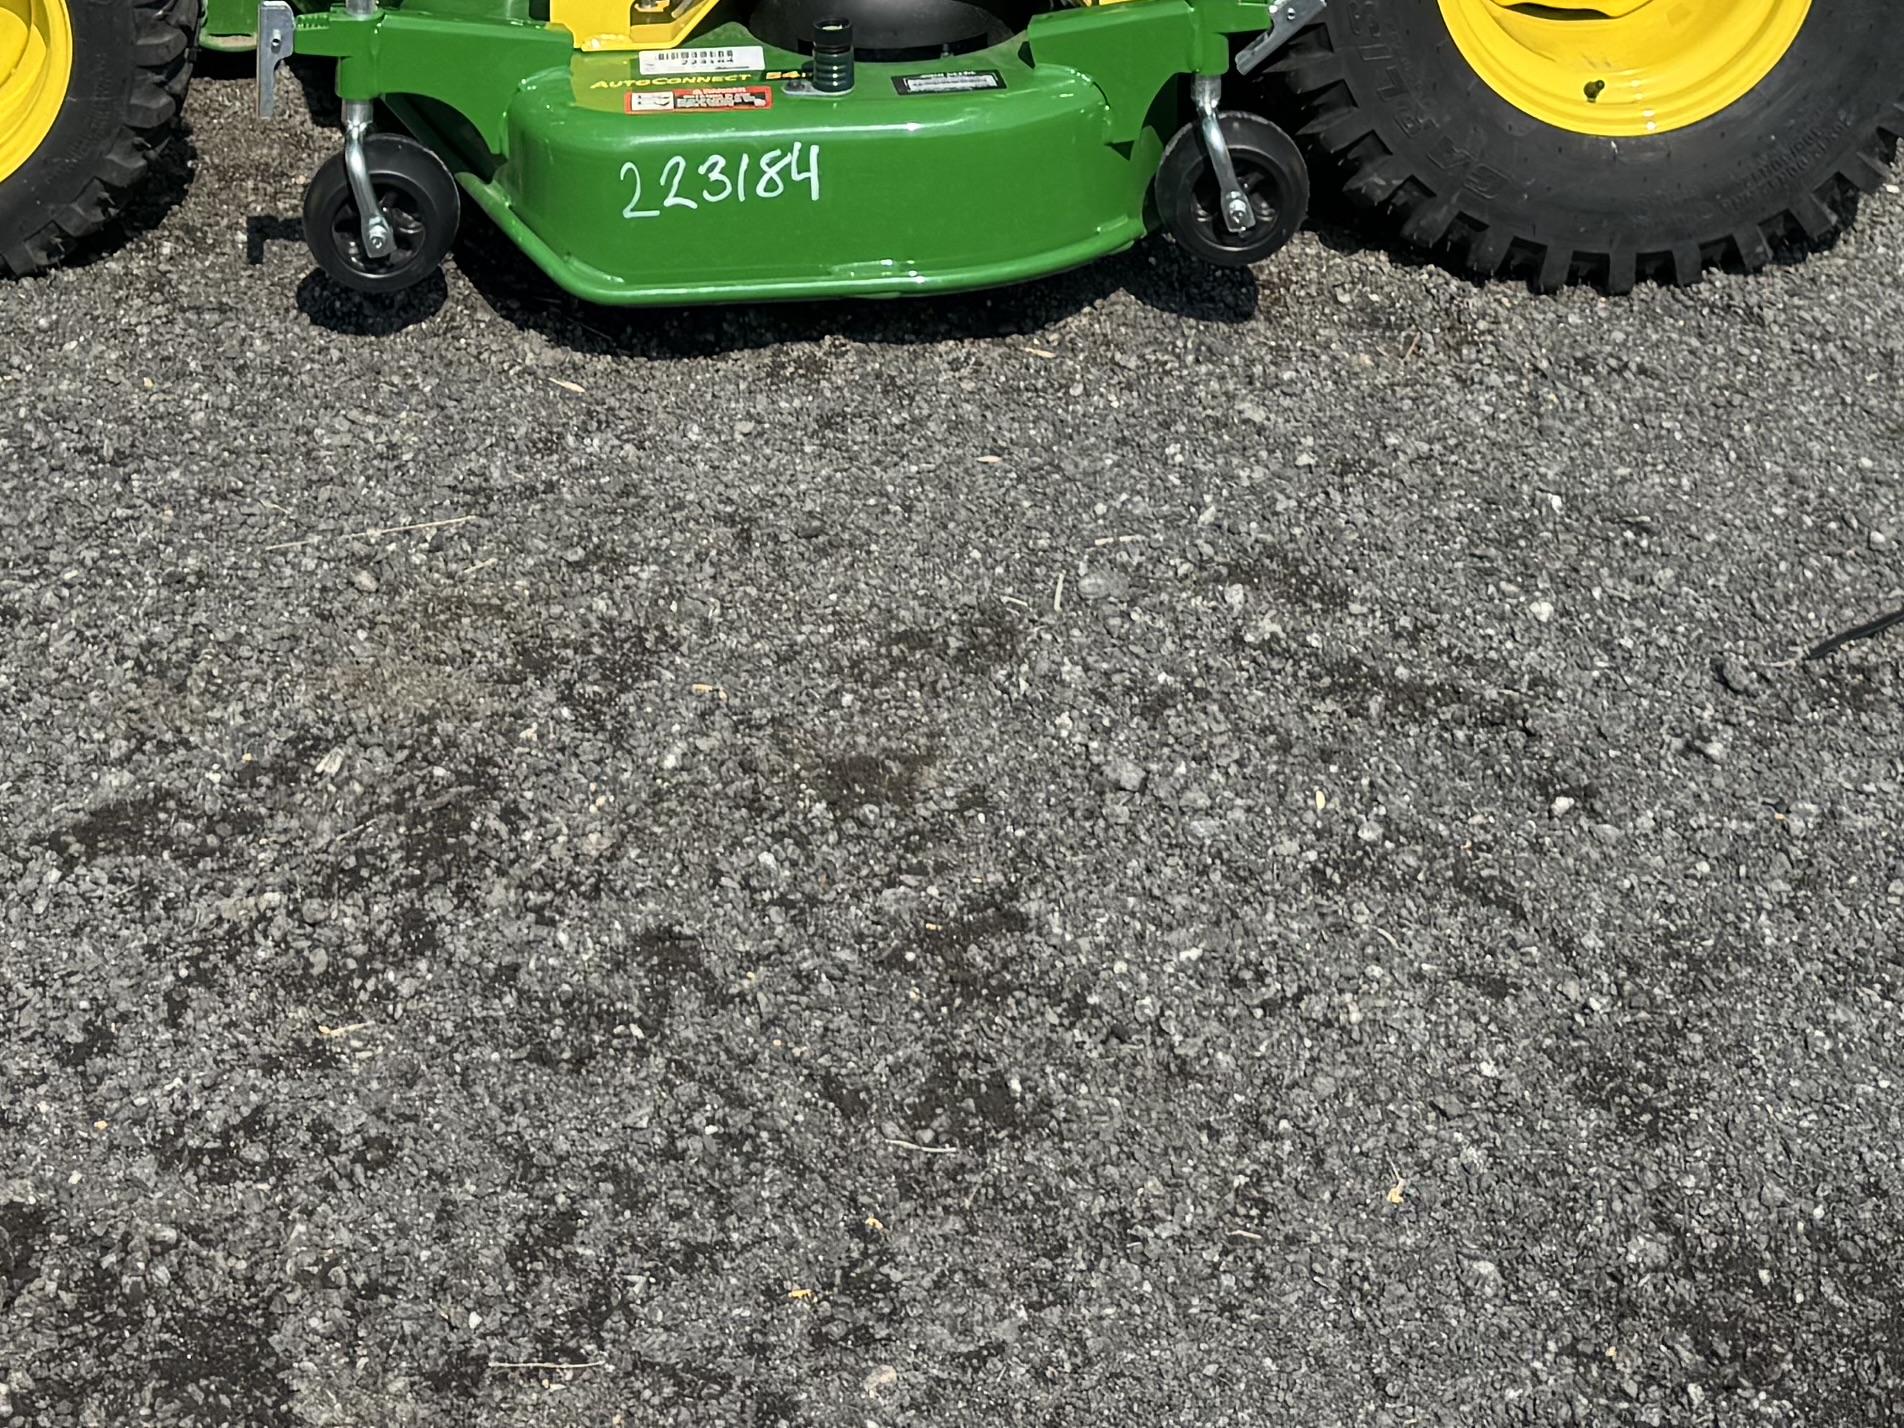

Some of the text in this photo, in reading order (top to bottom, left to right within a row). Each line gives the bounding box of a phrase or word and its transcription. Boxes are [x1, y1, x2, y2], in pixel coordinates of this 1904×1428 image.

[590, 70, 808, 90] AUTOCONNECT 54
[619, 141, 821, 219] 223184
